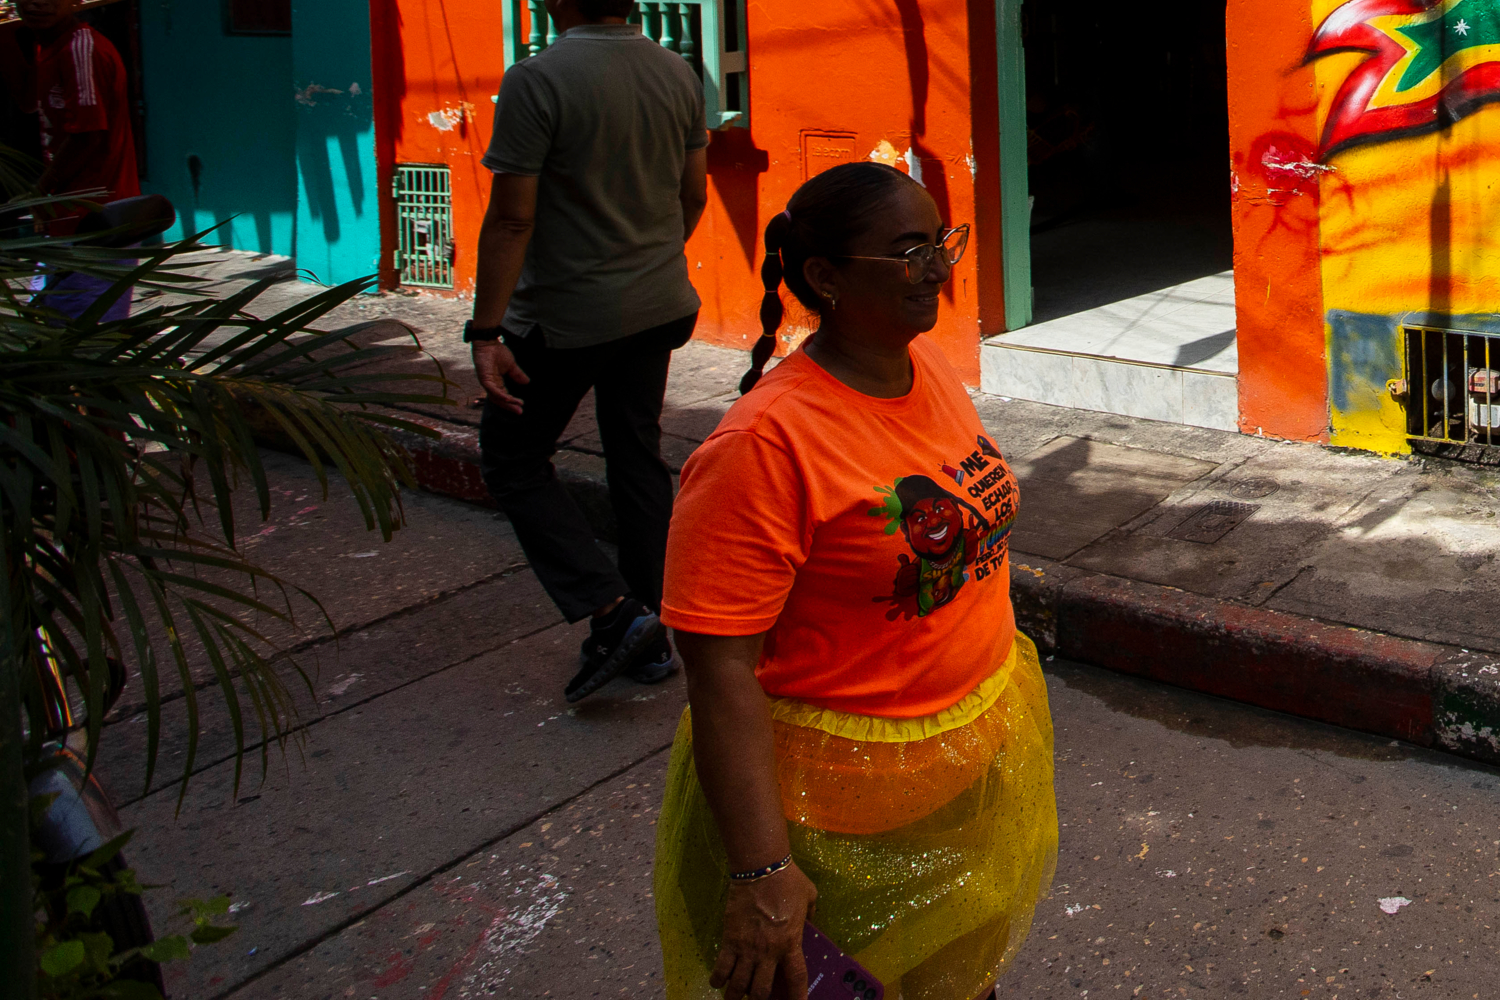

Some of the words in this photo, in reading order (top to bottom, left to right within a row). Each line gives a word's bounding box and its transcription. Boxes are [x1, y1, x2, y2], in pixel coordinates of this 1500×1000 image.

[959, 450, 990, 478] ME
[967, 463, 1008, 499] QUIEREN
[982, 480, 1013, 512] ECHAR
[994, 498, 1013, 522] LOS
[974, 564, 991, 581] DE
[807, 972, 824, 996] SAMSU
